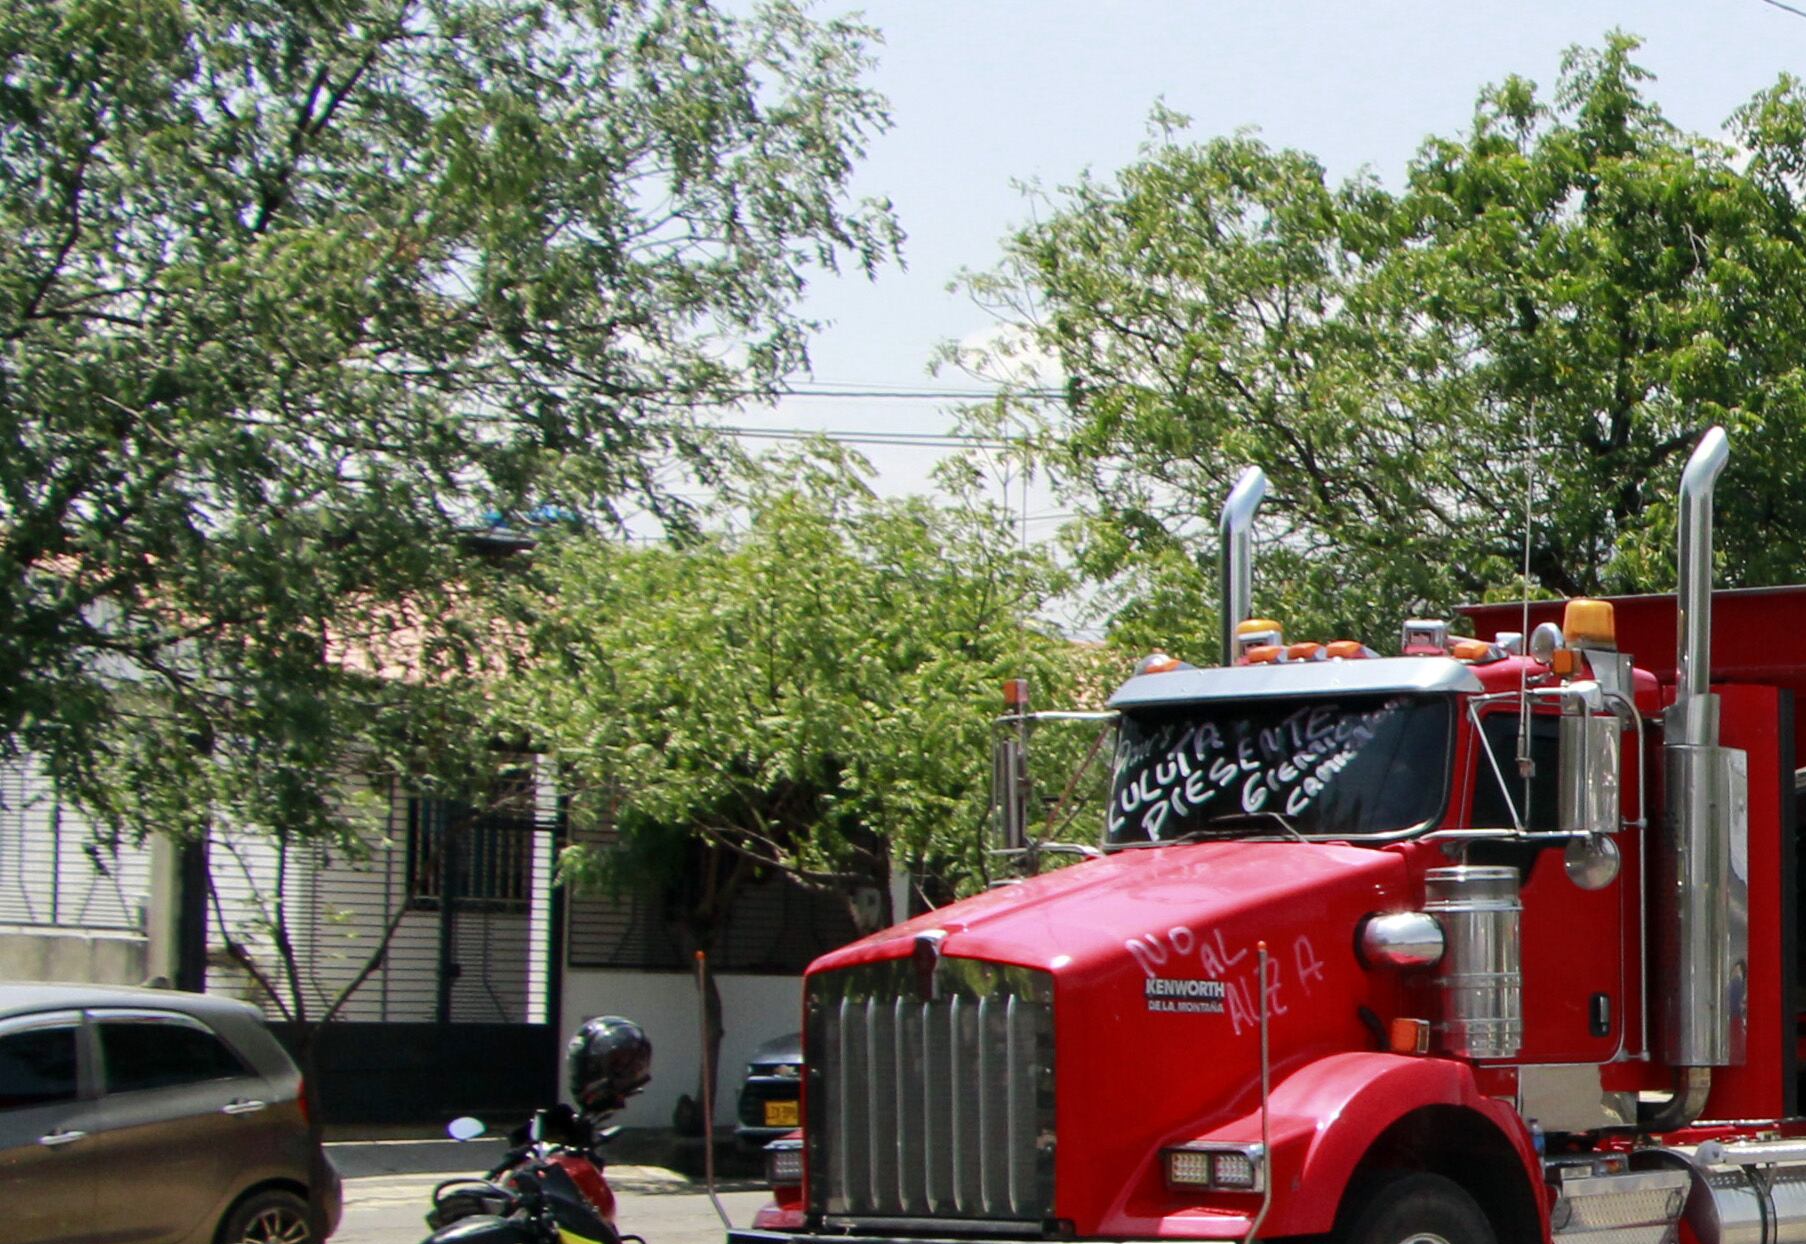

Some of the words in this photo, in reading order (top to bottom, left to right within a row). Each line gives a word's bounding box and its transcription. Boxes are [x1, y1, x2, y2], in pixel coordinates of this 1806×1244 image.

[1123, 925, 1195, 978] NO
[1200, 928, 1247, 979] AL
[1145, 978, 1225, 998] KENWORTH
